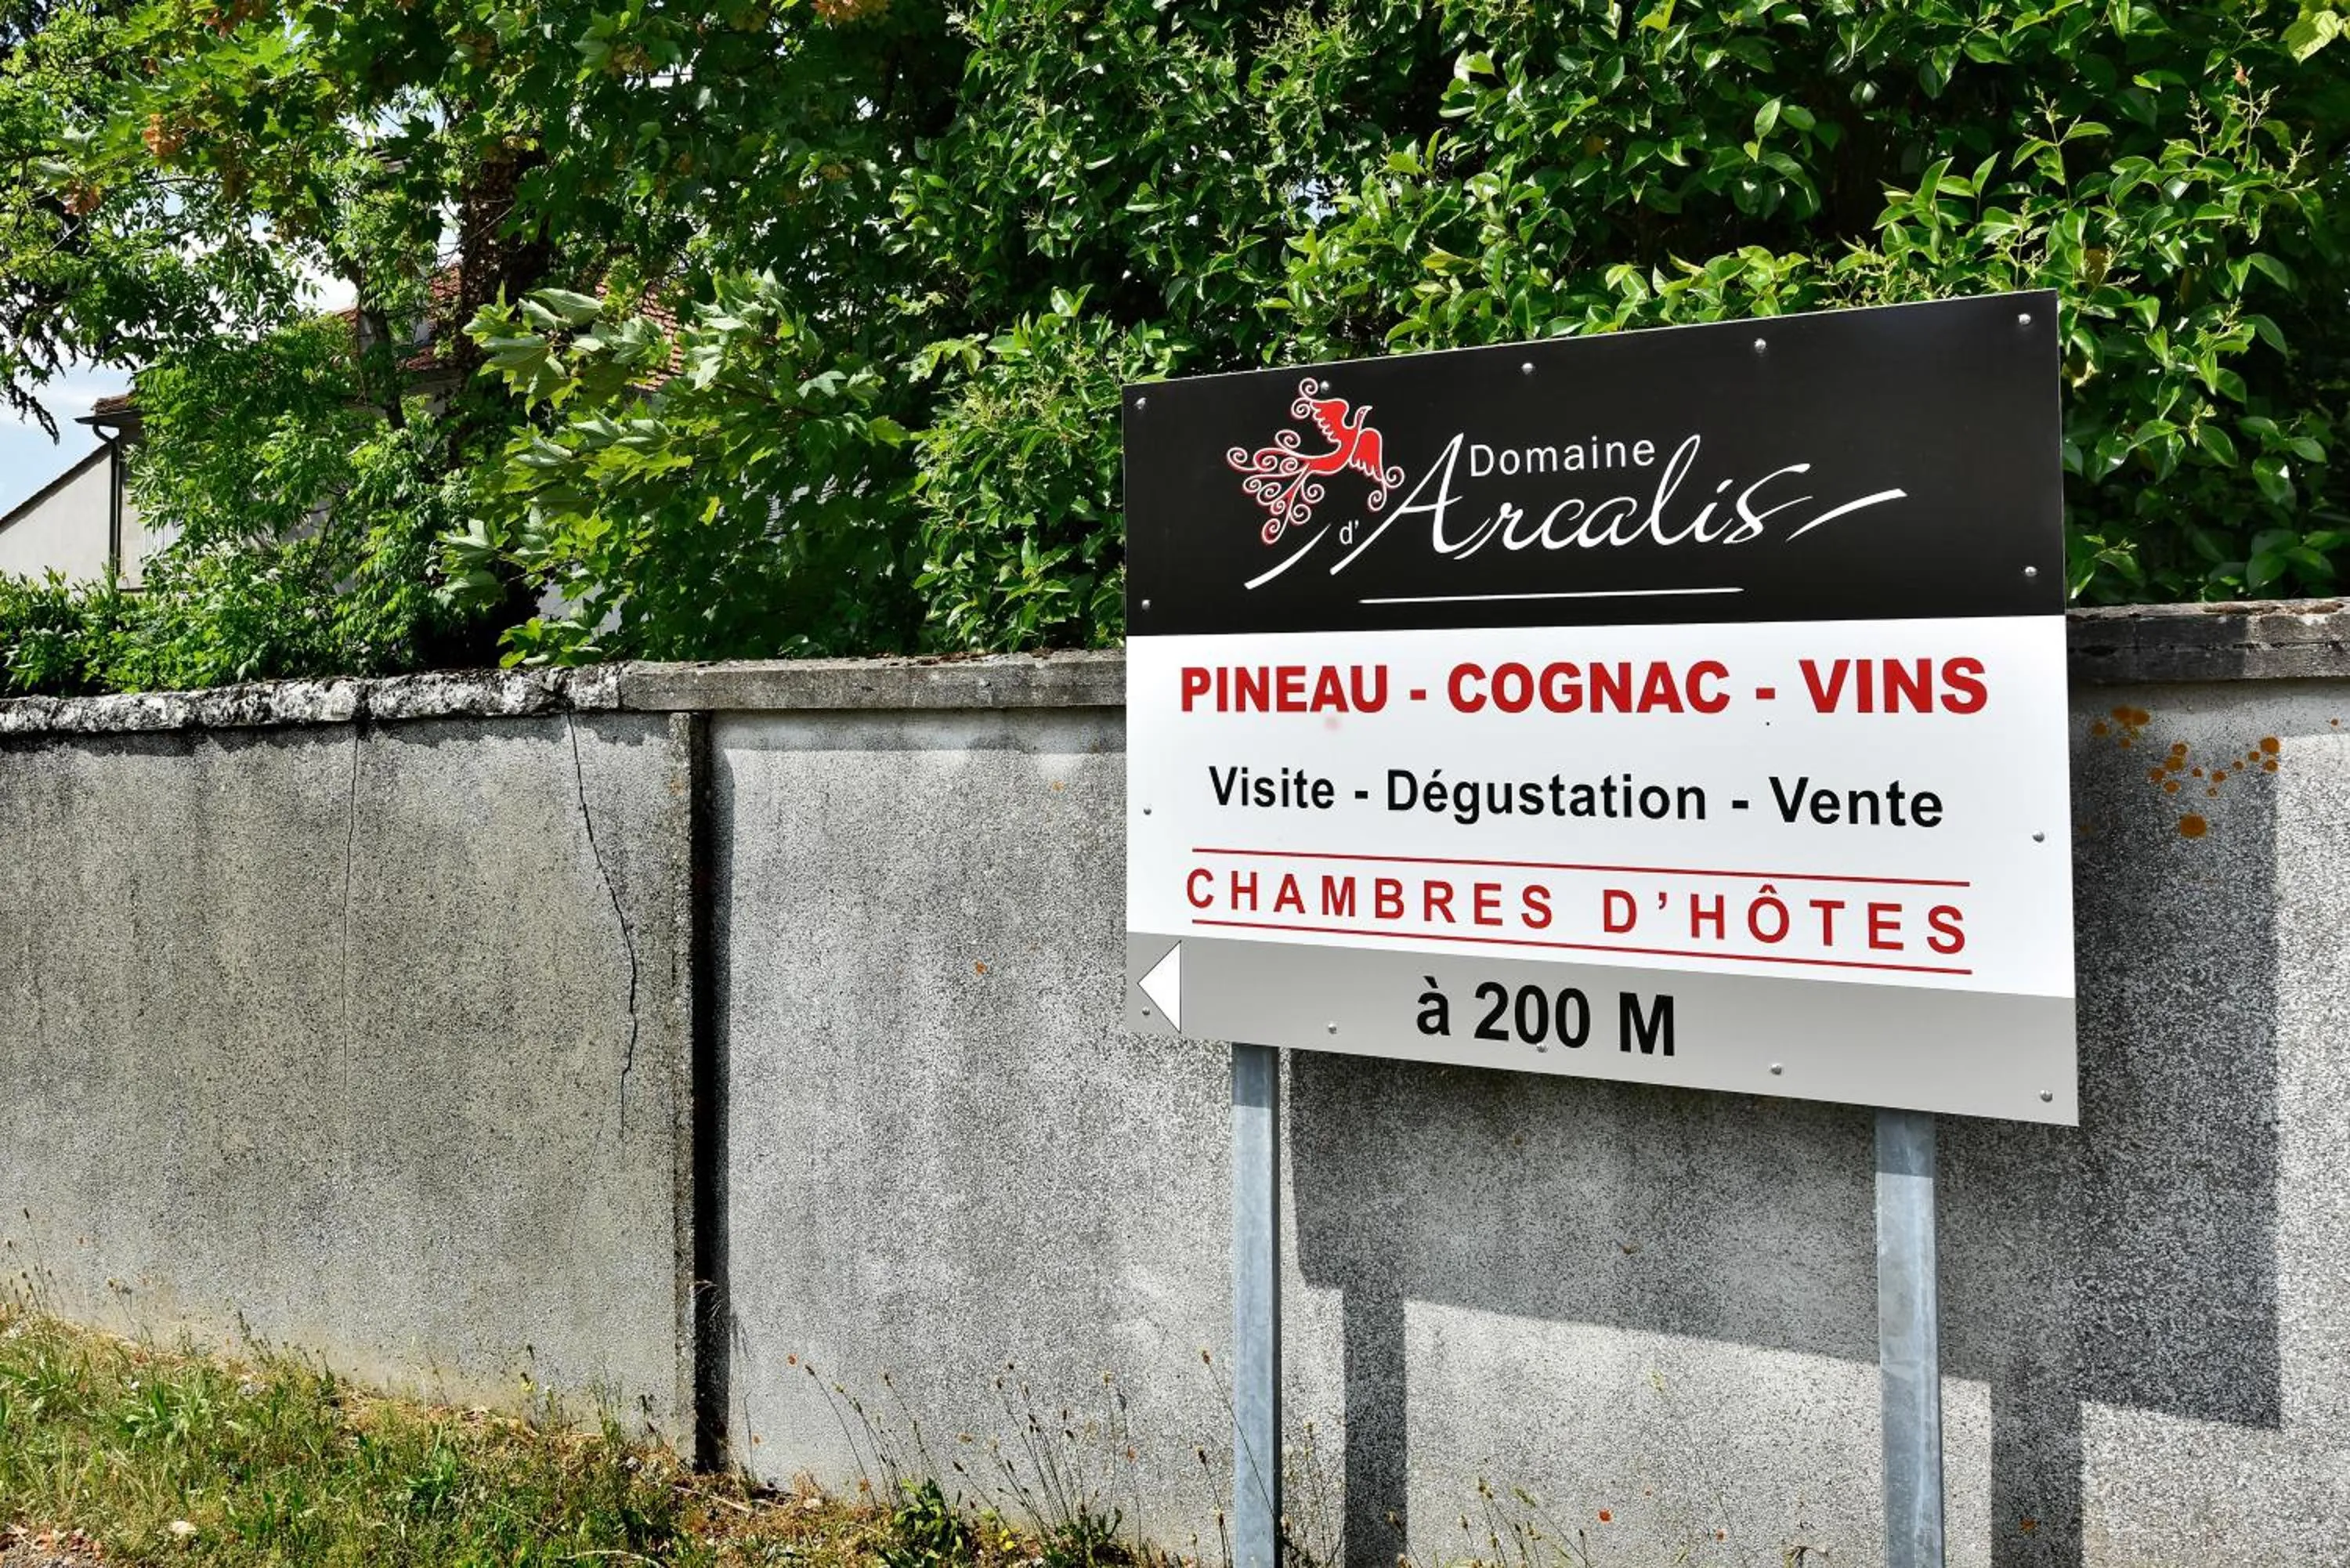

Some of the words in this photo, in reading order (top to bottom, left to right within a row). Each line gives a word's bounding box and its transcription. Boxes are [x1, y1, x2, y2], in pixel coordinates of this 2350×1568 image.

[1470, 439, 1655, 477] Domaine
[1329, 432, 1813, 576] Arcalis
[1180, 663, 1389, 714] PINEAU
[1448, 659, 1730, 715] COGNAC
[1799, 656, 1988, 715] VINS
[1209, 766, 1335, 809] Visite
[1387, 769, 1705, 825] Dégustation
[1768, 776, 1943, 828] Vente
[1186, 867, 1553, 930] CHAMBRES
[1417, 975, 1451, 1036] à
[1474, 981, 1592, 1049] 200
[1619, 992, 1675, 1057] M
